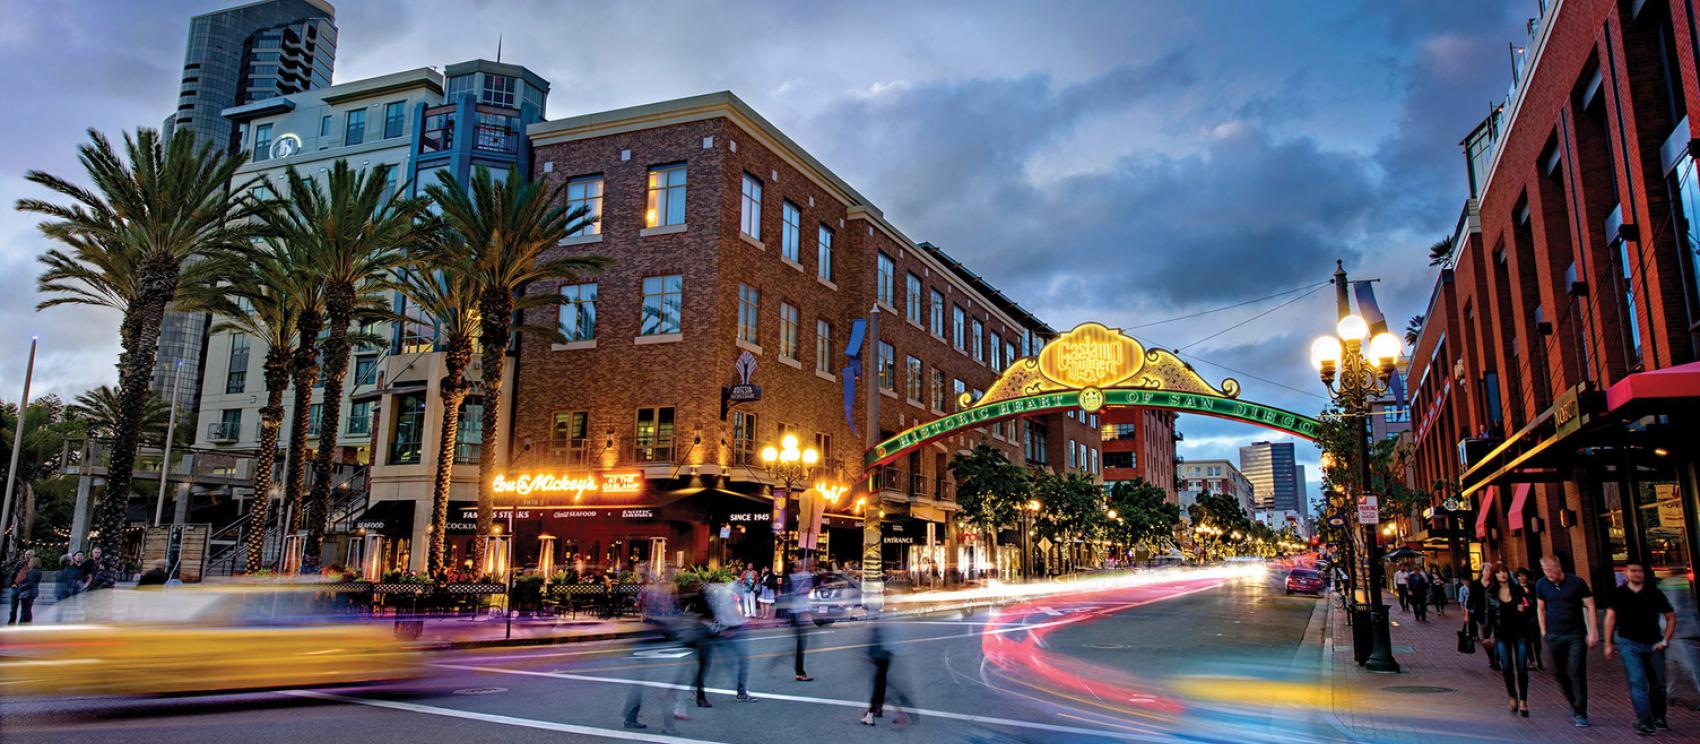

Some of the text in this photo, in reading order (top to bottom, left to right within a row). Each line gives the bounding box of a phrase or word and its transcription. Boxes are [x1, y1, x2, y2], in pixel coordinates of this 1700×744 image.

[898, 392, 1313, 447] HISTORIC HEART OF SAN DIEGO
[730, 513, 770, 521] SINCE 1945
